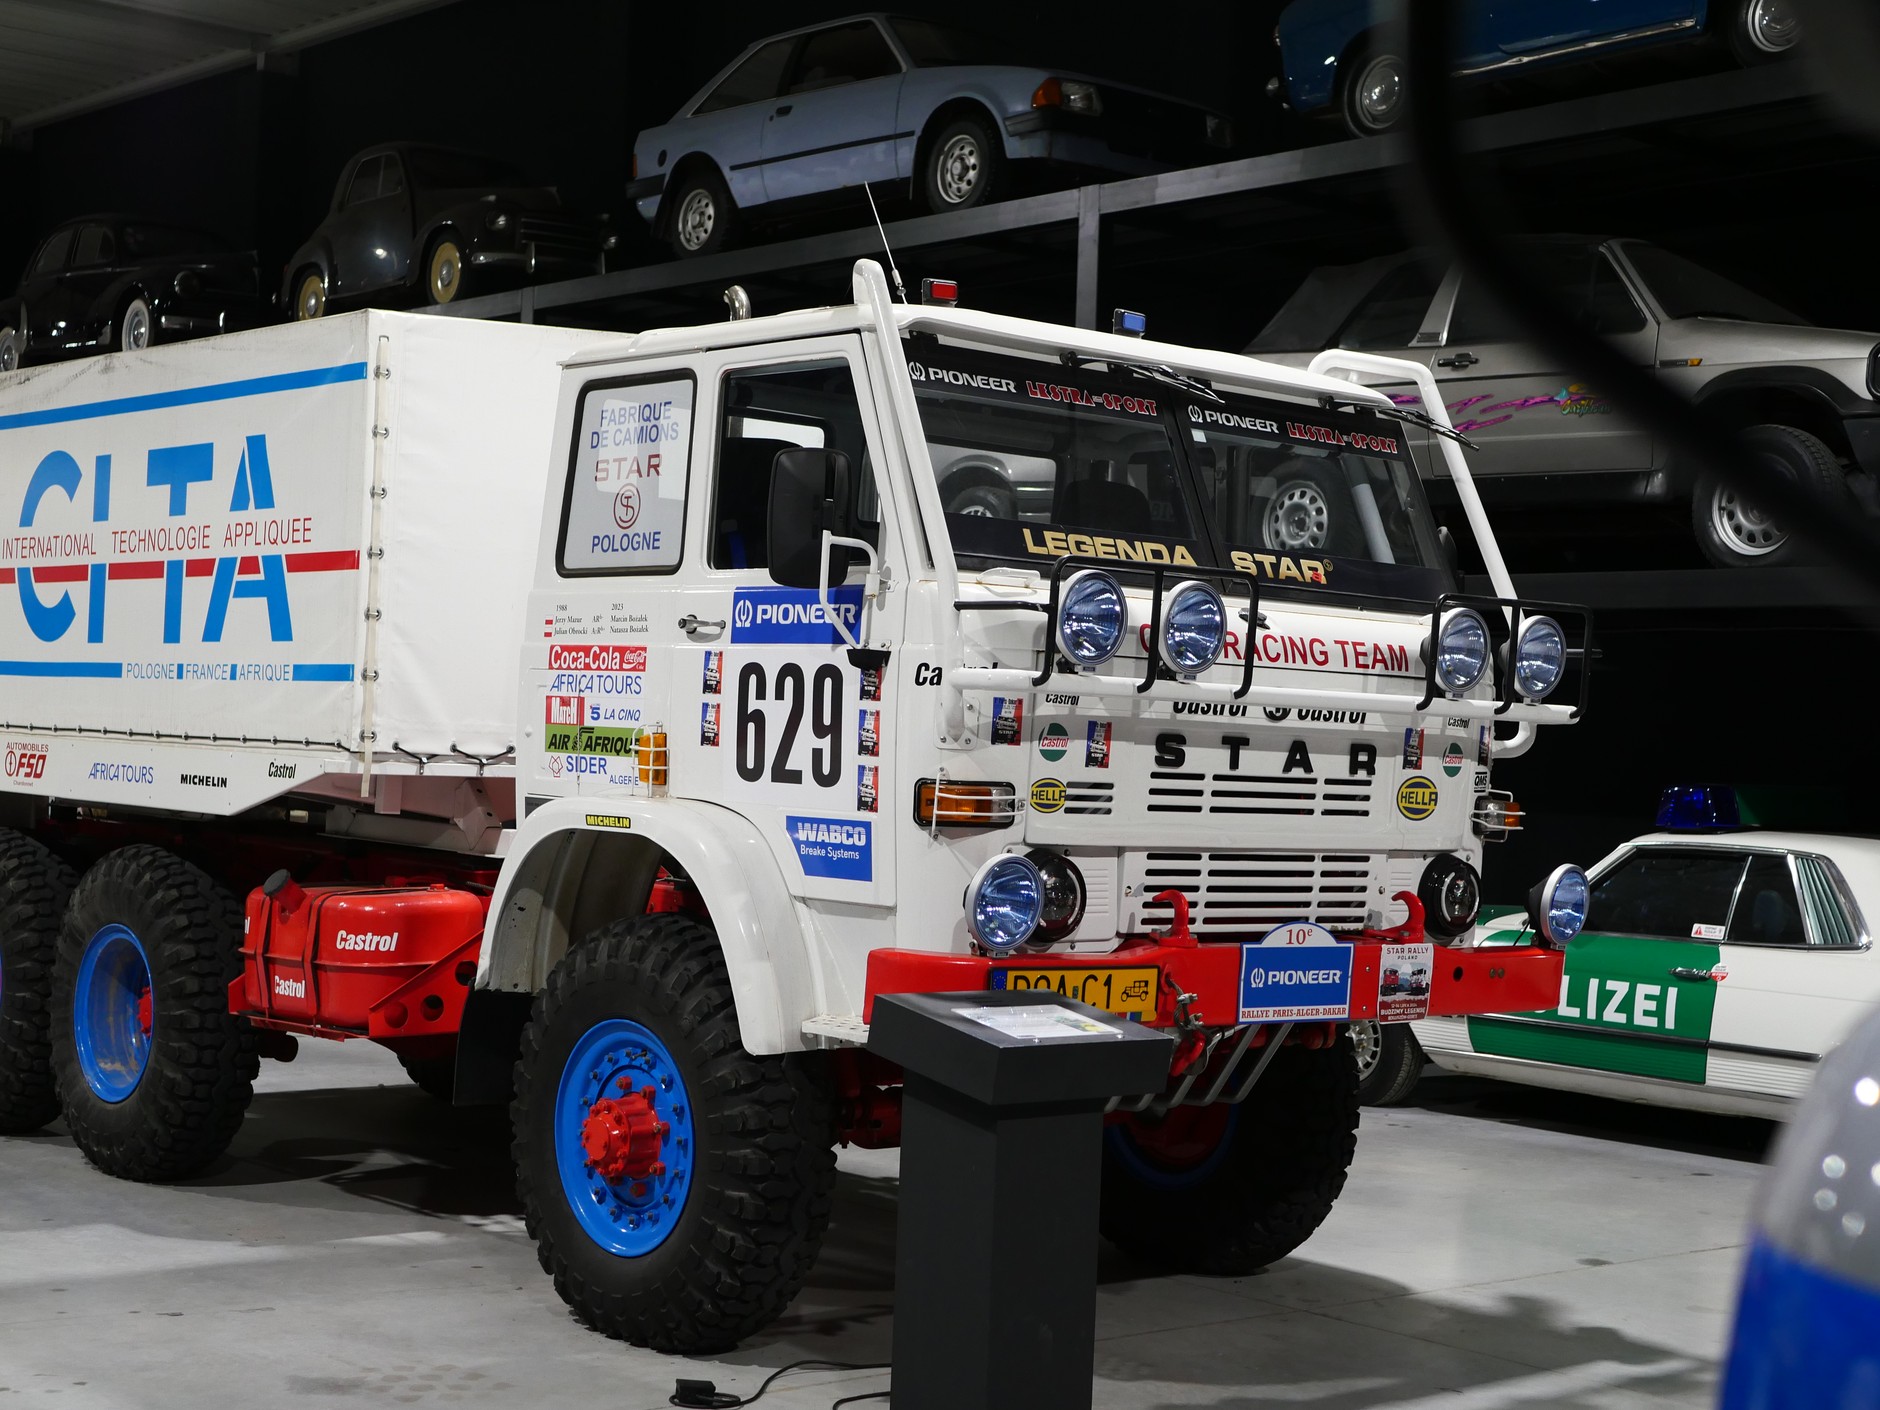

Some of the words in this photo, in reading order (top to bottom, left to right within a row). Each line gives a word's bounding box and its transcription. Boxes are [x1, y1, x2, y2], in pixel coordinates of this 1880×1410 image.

[929, 367, 1017, 393] PIONEER
[1026, 380, 1157, 416] LESTRA-SPORT
[600, 401, 672, 427] FABRIQUE
[590, 430, 609, 449] DE
[613, 421, 679, 446] CAMIONS
[1205, 409, 1279, 434] PIONEER
[1286, 421, 1398, 454] LESTRA-SPORT
[594, 453, 663, 482] STAR
[1, 532, 97, 560] INTERNATIONAL
[111, 525, 211, 554] TECHNOLOGIE
[223, 517, 313, 548] APPLIQUEE
[591, 531, 662, 553] POLOGNE
[1022, 528, 1198, 566] LEGENDA
[1231, 551, 1327, 584] STAR
[611, 603, 624, 611] 2023
[756, 603, 856, 625] PIONEER
[610, 615, 628, 623] Marcin
[551, 645, 620, 670] Coca-Cola
[1223, 629, 1329, 667] RACING
[1334, 639, 1410, 672] TEAM
[126, 663, 174, 679] POLOGNE
[186, 664, 228, 681] FRANCE
[239, 664, 290, 681] AFRIQUE
[590, 707, 601, 721] 5
[604, 708, 615, 720] LA
[618, 709, 641, 721] CINQ
[736, 661, 844, 788] 629
[6, 741, 49, 752] AUTOMOBILES
[548, 733, 570, 751] AIR
[1041, 736, 1070, 748] Castrol
[1154, 733, 1377, 776] STAR
[1444, 754, 1464, 765] Castrol
[15, 753, 47, 779] FSO
[268, 761, 297, 780] Castrol
[566, 755, 607, 775] SIDER
[180, 773, 228, 788] MICHELIN
[609, 774, 639, 786] ALGERE
[1031, 789, 1067, 802] HELLA
[1400, 791, 1438, 806] HELLA
[586, 815, 630, 828] MICHELIN
[797, 822, 866, 846] WABCO
[827, 846, 860, 860] Systems
[336, 930, 399, 952] Castrol
[1386, 947, 1405, 955] STAR
[1407, 946, 1429, 954] RALLY
[274, 975, 305, 999] Castrol
[1267, 970, 1341, 985] PIONEER
[1557, 974, 1678, 1029] LIZEI
[1241, 1010, 1270, 1019] RALLYE
[1272, 1007, 1347, 1018] PARIS-ALGER-DAKAR
